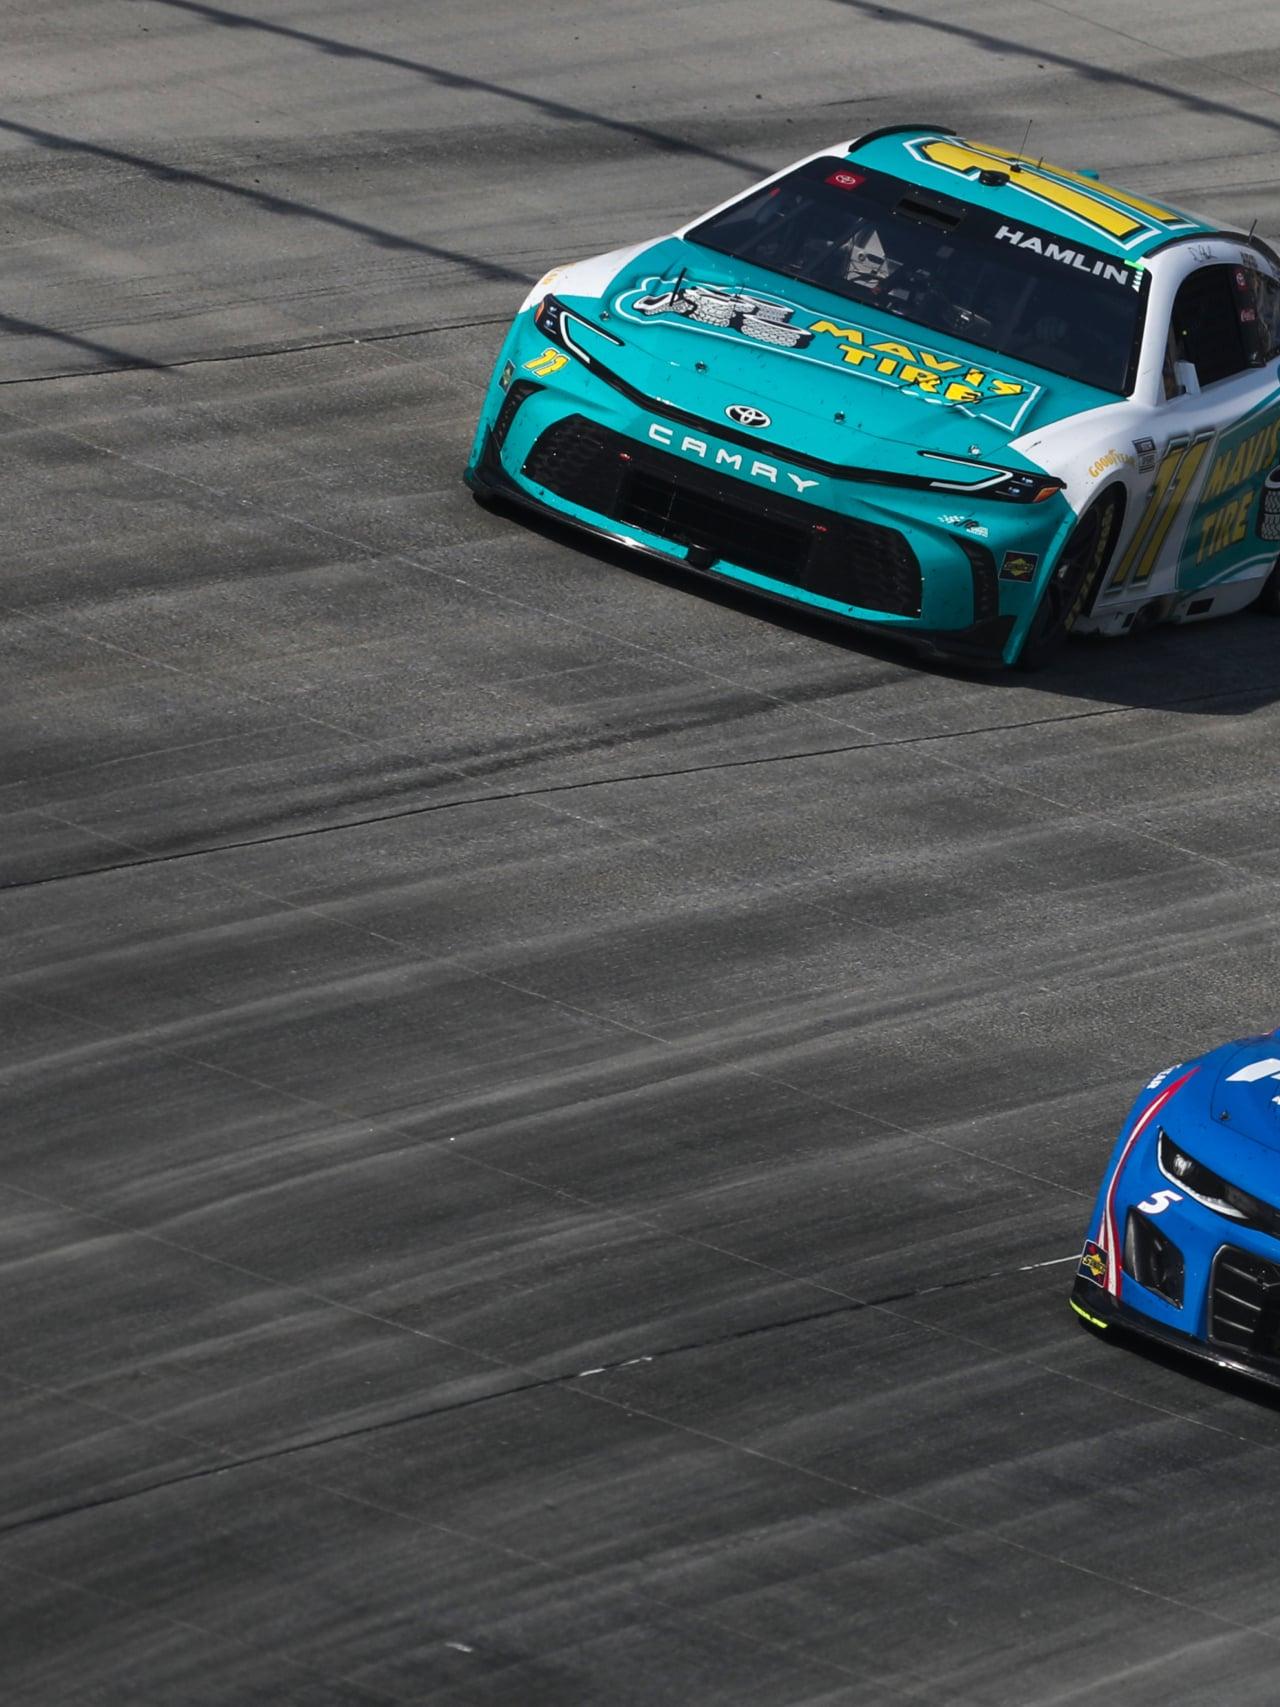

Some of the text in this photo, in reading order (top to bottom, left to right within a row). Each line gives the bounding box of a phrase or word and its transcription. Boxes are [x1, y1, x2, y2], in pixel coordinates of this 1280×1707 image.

[994, 225, 1129, 286] HAMLIN
[522, 346, 571, 378] 11
[810, 320, 1025, 397] MAVIS
[839, 343, 984, 405] TIRE
[648, 422, 821, 493] CAMRY
[1106, 430, 1217, 588] 11
[1197, 490, 1254, 564] TIRE
[1137, 1191, 1182, 1214] 5
